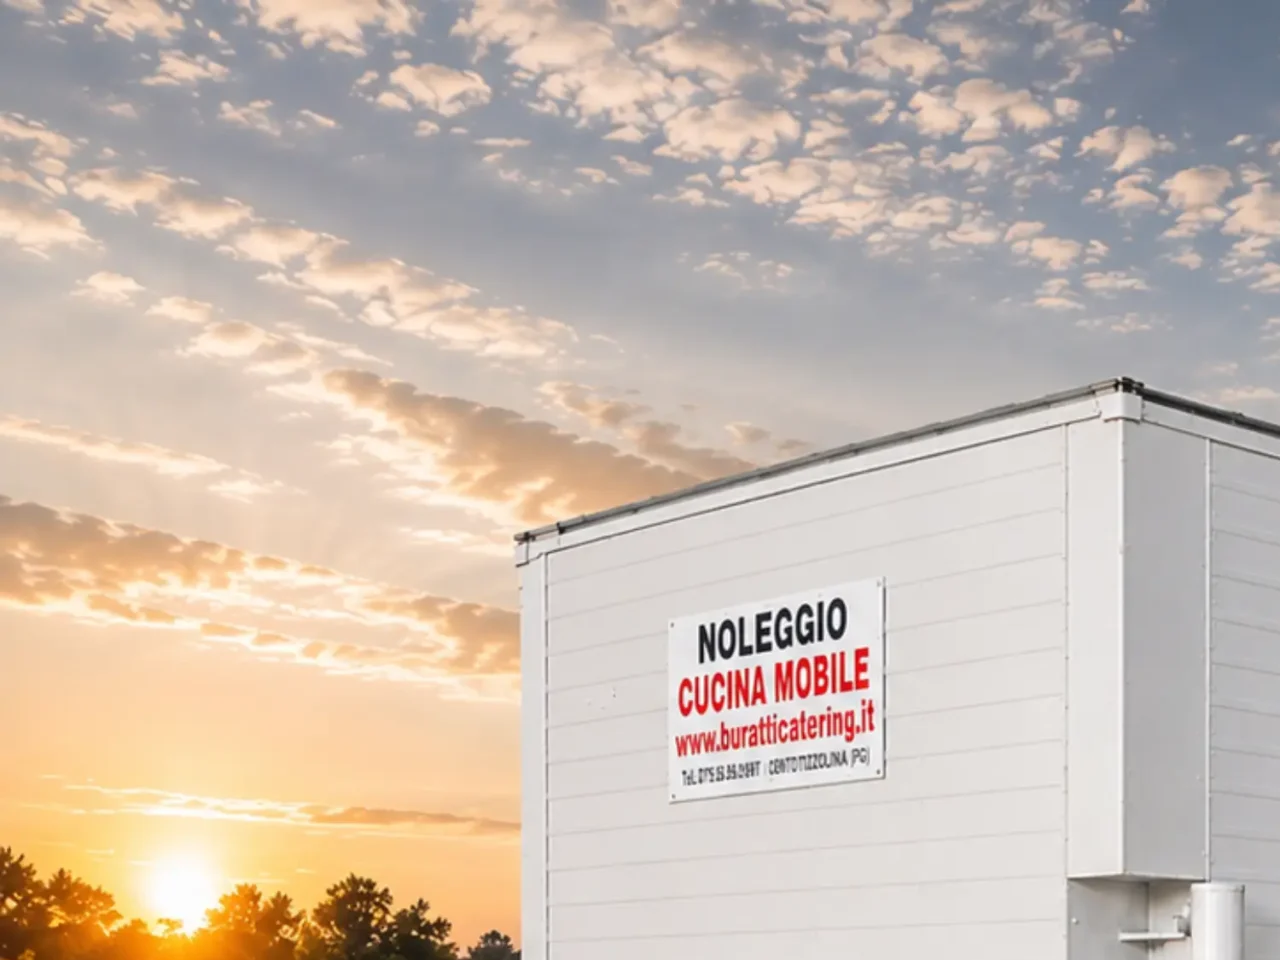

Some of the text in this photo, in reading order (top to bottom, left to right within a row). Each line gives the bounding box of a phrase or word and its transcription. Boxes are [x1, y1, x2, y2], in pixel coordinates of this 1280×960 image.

[698, 597, 848, 665] NOLEGGIO
[678, 647, 870, 717] CUCINA MOBILE
[675, 699, 875, 757] www.buratticatering.it
